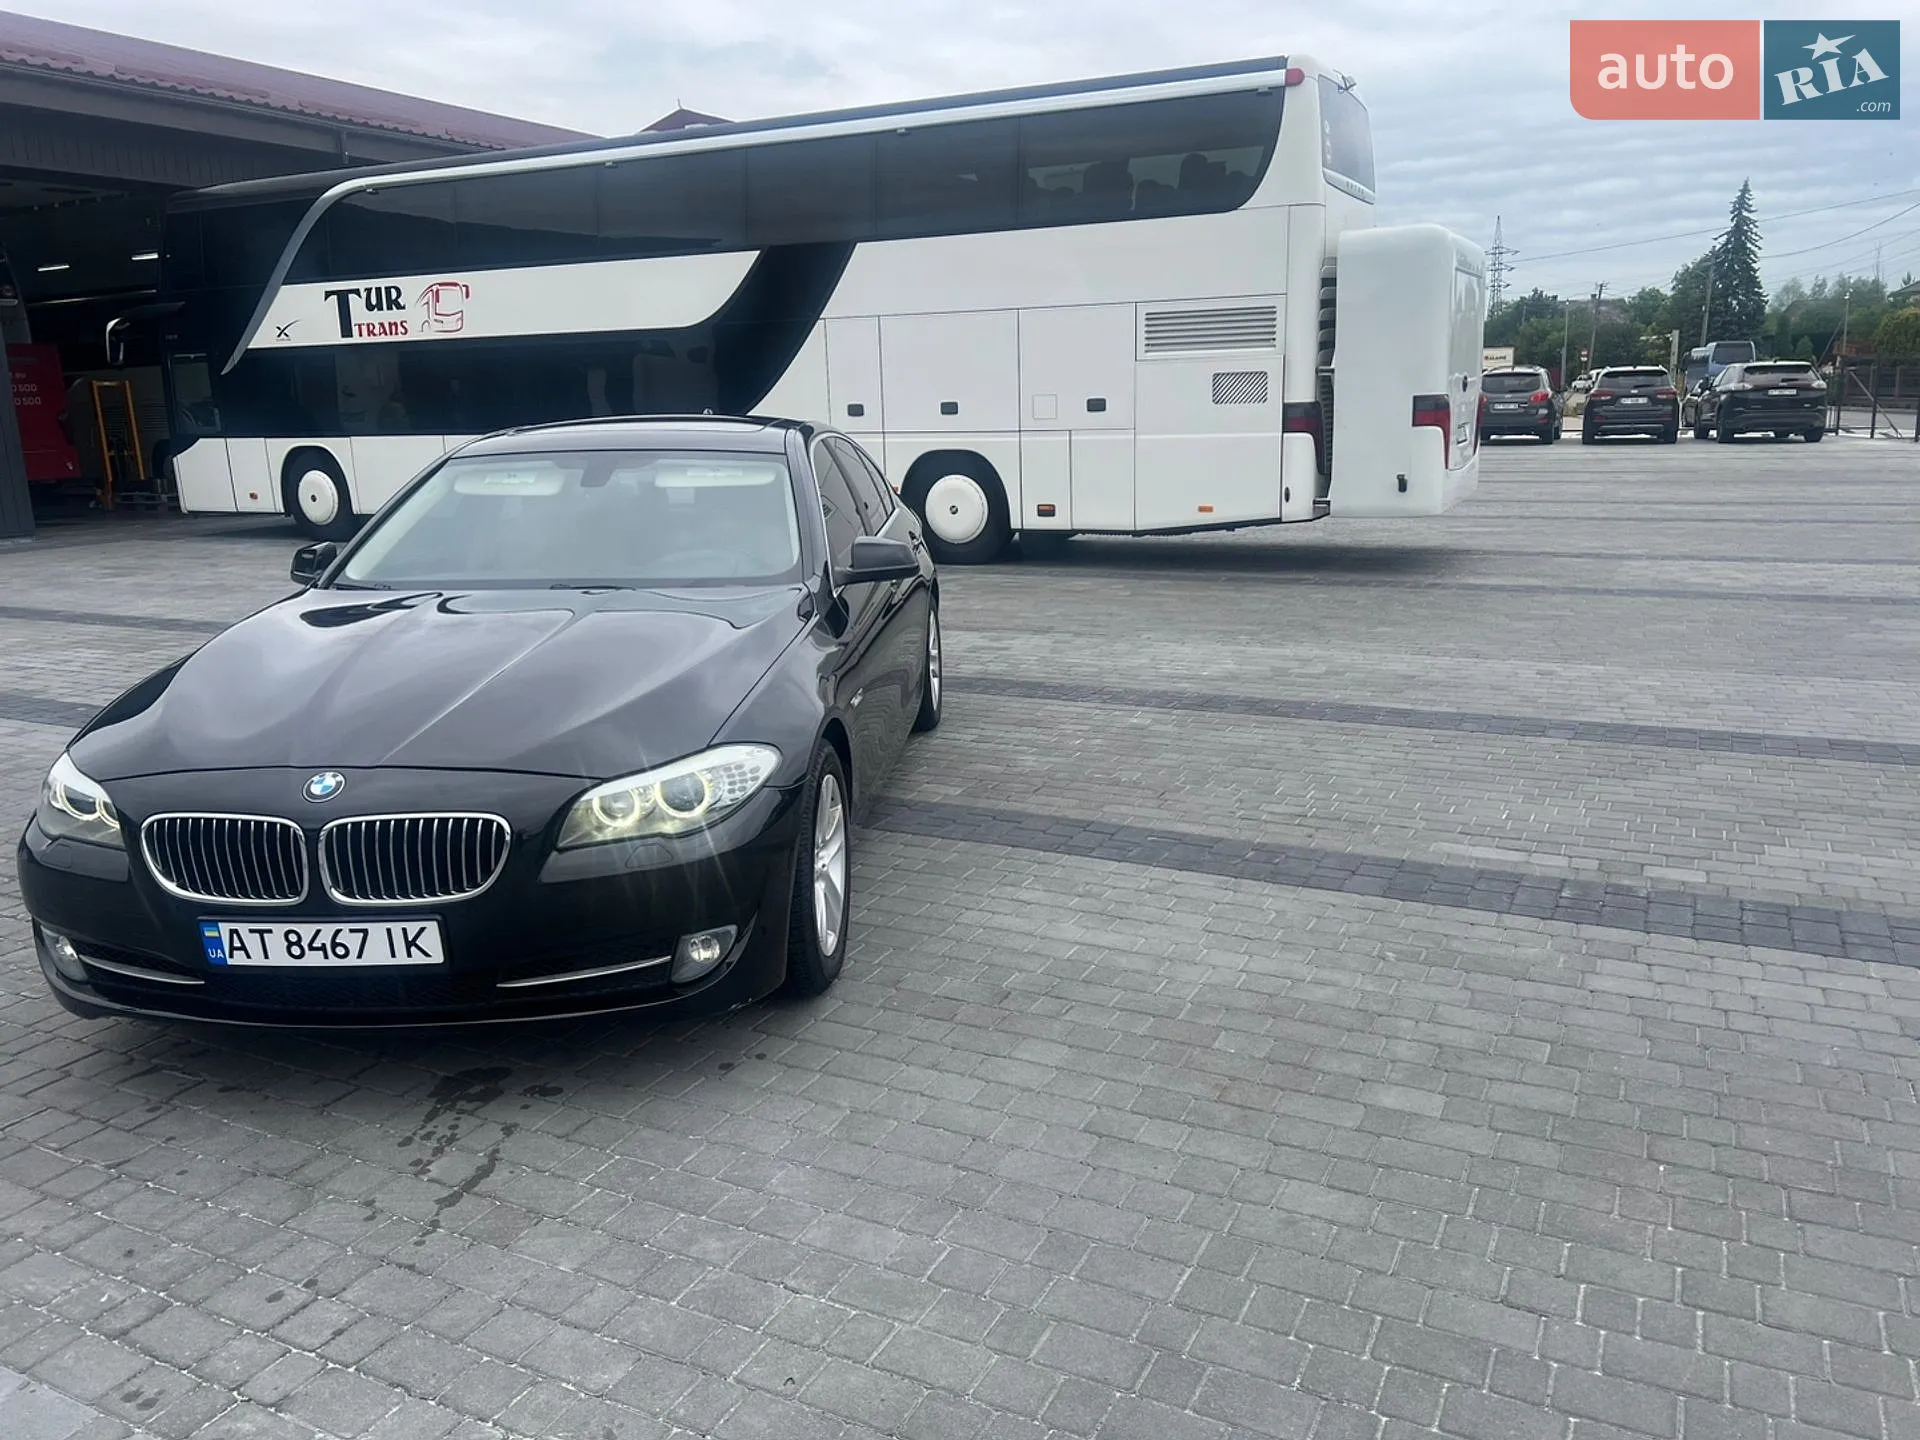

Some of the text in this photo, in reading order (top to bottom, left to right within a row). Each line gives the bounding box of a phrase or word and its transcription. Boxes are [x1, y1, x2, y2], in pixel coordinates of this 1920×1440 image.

[324, 285, 406, 339] TUR
[354, 320, 408, 337] TRANS
[208, 948, 224, 959] UA
[227, 926, 432, 960] AT 8467 IK
